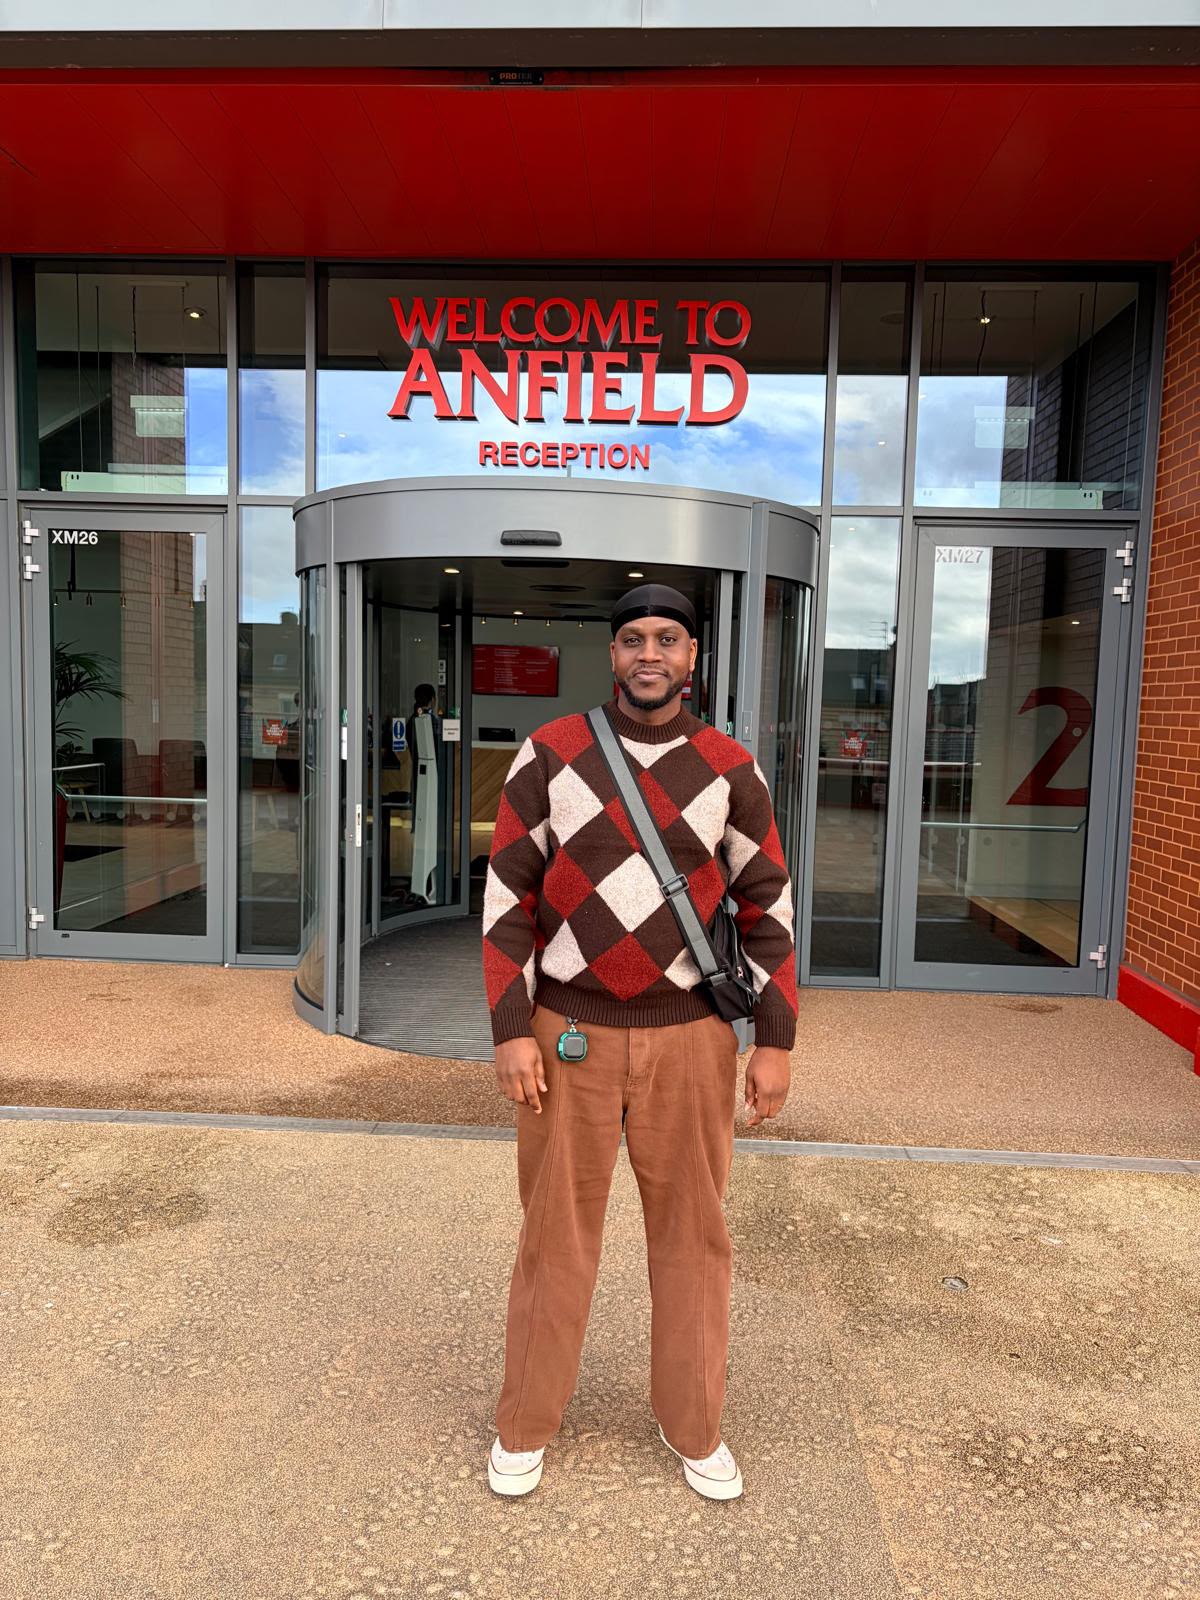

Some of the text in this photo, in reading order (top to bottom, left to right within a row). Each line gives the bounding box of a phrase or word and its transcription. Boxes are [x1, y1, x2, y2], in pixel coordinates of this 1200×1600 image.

[388, 297, 752, 347] WELCOME TO
[386, 348, 750, 425] ANFIELD
[478, 440, 651, 469] RECEPTION
[51, 529, 99, 545] XM26
[936, 548, 984, 564] XM27
[1006, 686, 1093, 808] 2
